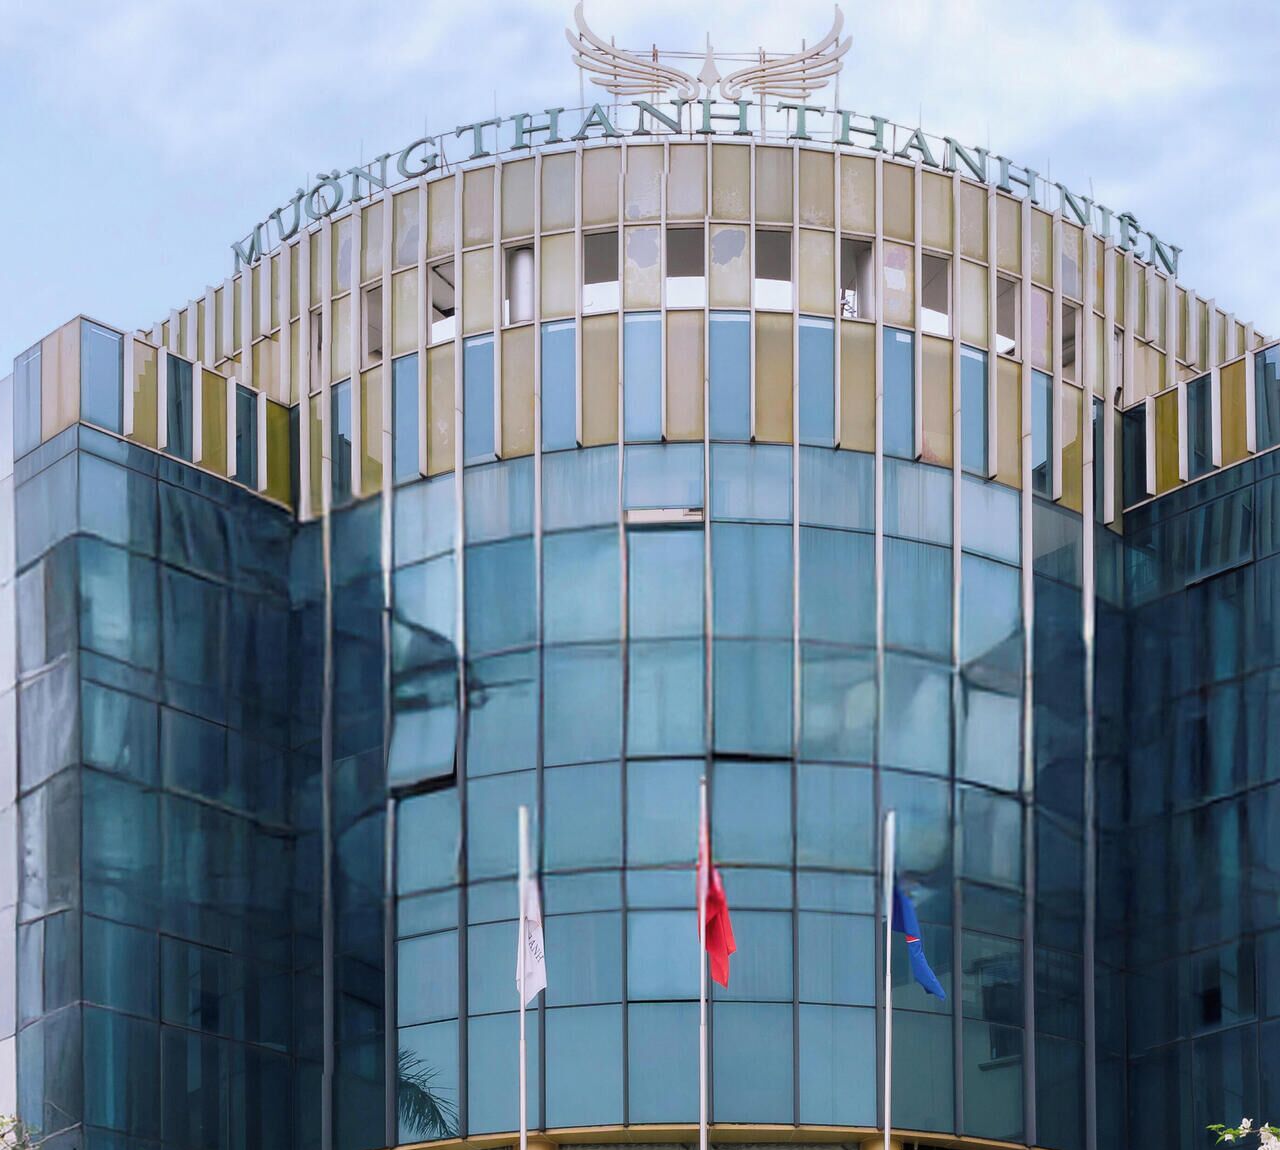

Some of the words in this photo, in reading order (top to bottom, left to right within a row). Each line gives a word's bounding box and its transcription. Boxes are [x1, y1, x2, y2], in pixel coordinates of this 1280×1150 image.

[455, 98, 754, 160] THANH
[776, 101, 1040, 205] THANH
[1055, 182, 1183, 279] NIÊN
